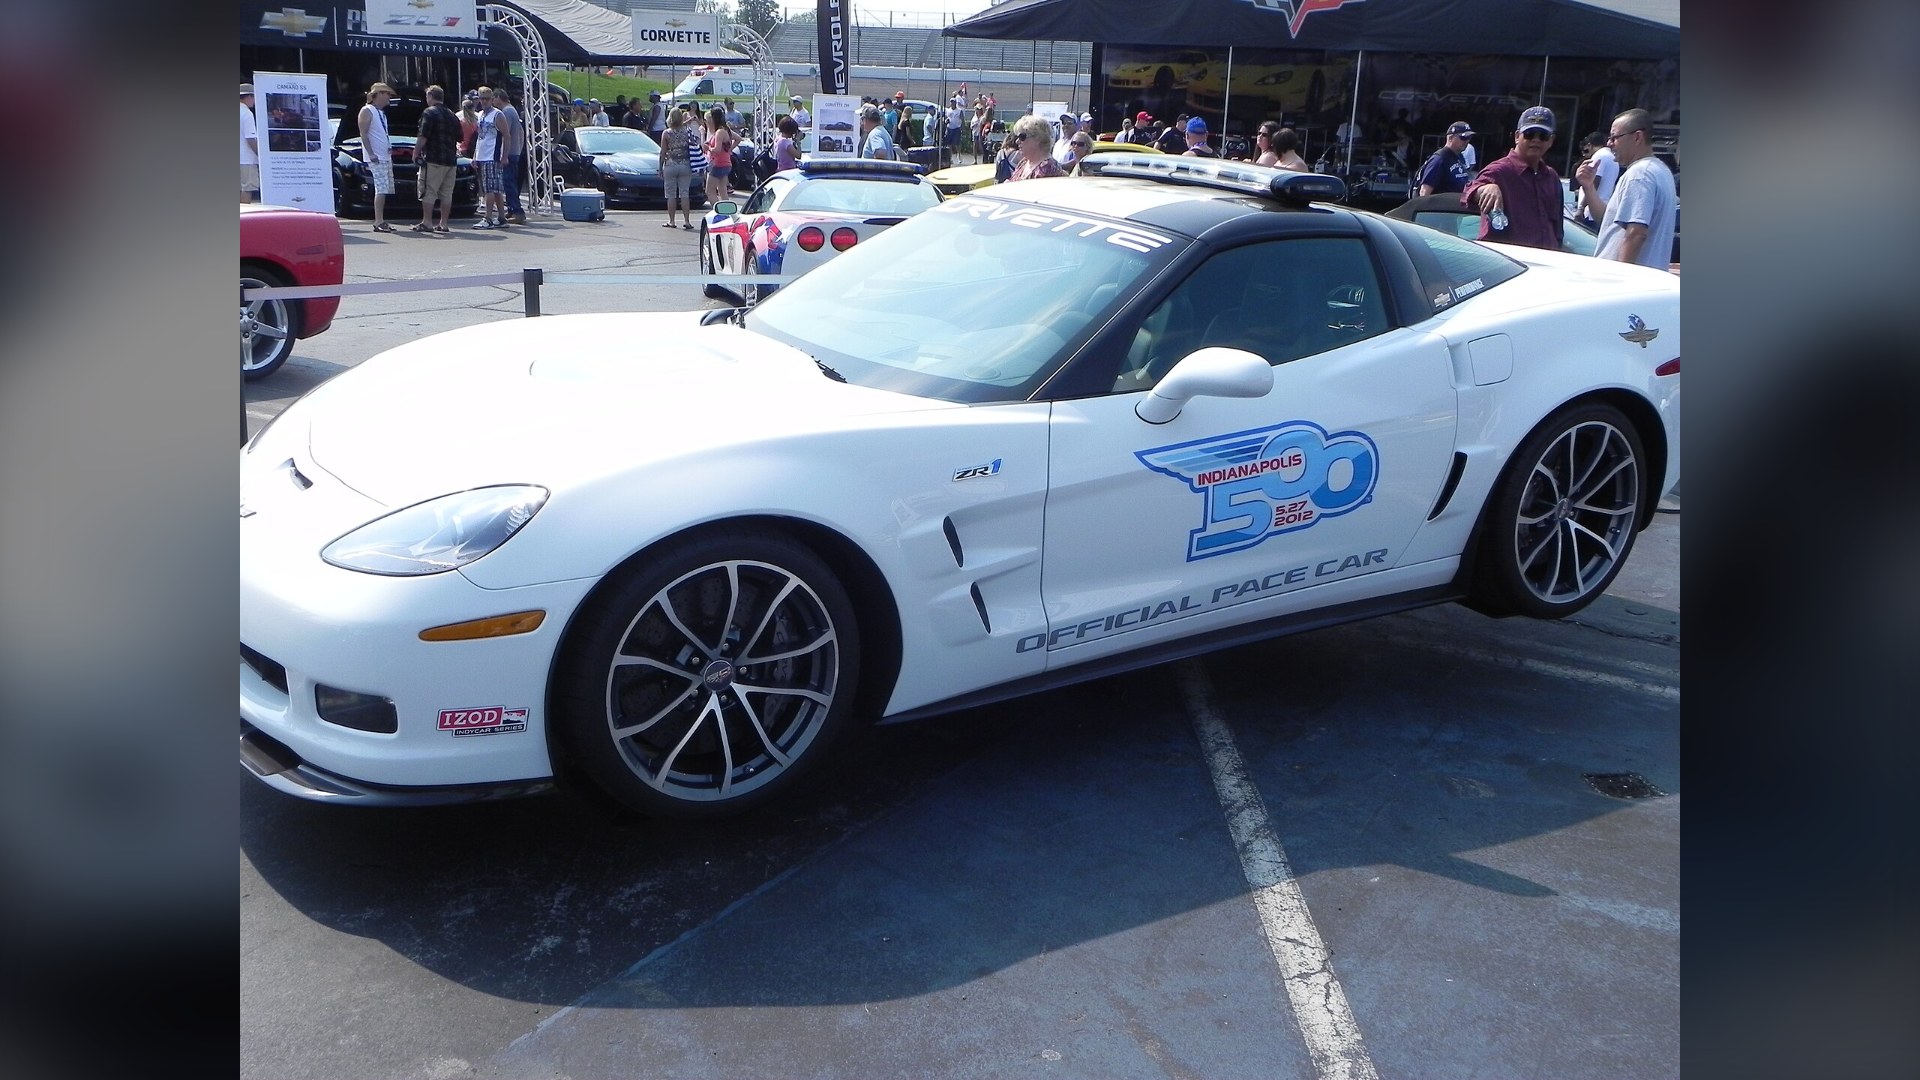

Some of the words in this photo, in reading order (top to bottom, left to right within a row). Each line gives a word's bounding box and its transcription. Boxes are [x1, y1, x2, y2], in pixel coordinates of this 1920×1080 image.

[383, 14, 461, 27] ZL1
[640, 29, 711, 44] CORVETTE
[347, 39, 400, 50] VEHICLES
[412, 44, 443, 53] PARTS
[453, 46, 490, 56] RACING
[954, 458, 1003, 480] ZR1
[1197, 453, 1303, 486] INDIANAPOLIS
[1194, 428, 1374, 553] 500
[1275, 500, 1308, 515] 5.27
[1273, 510, 1314, 527] 2012
[1016, 596, 1202, 654] OFFICIAL
[1211, 566, 1309, 604] PACE
[1315, 548, 1389, 578] CAR
[443, 710, 498, 726] IZOD
[494, 724, 523, 732] SERIES
